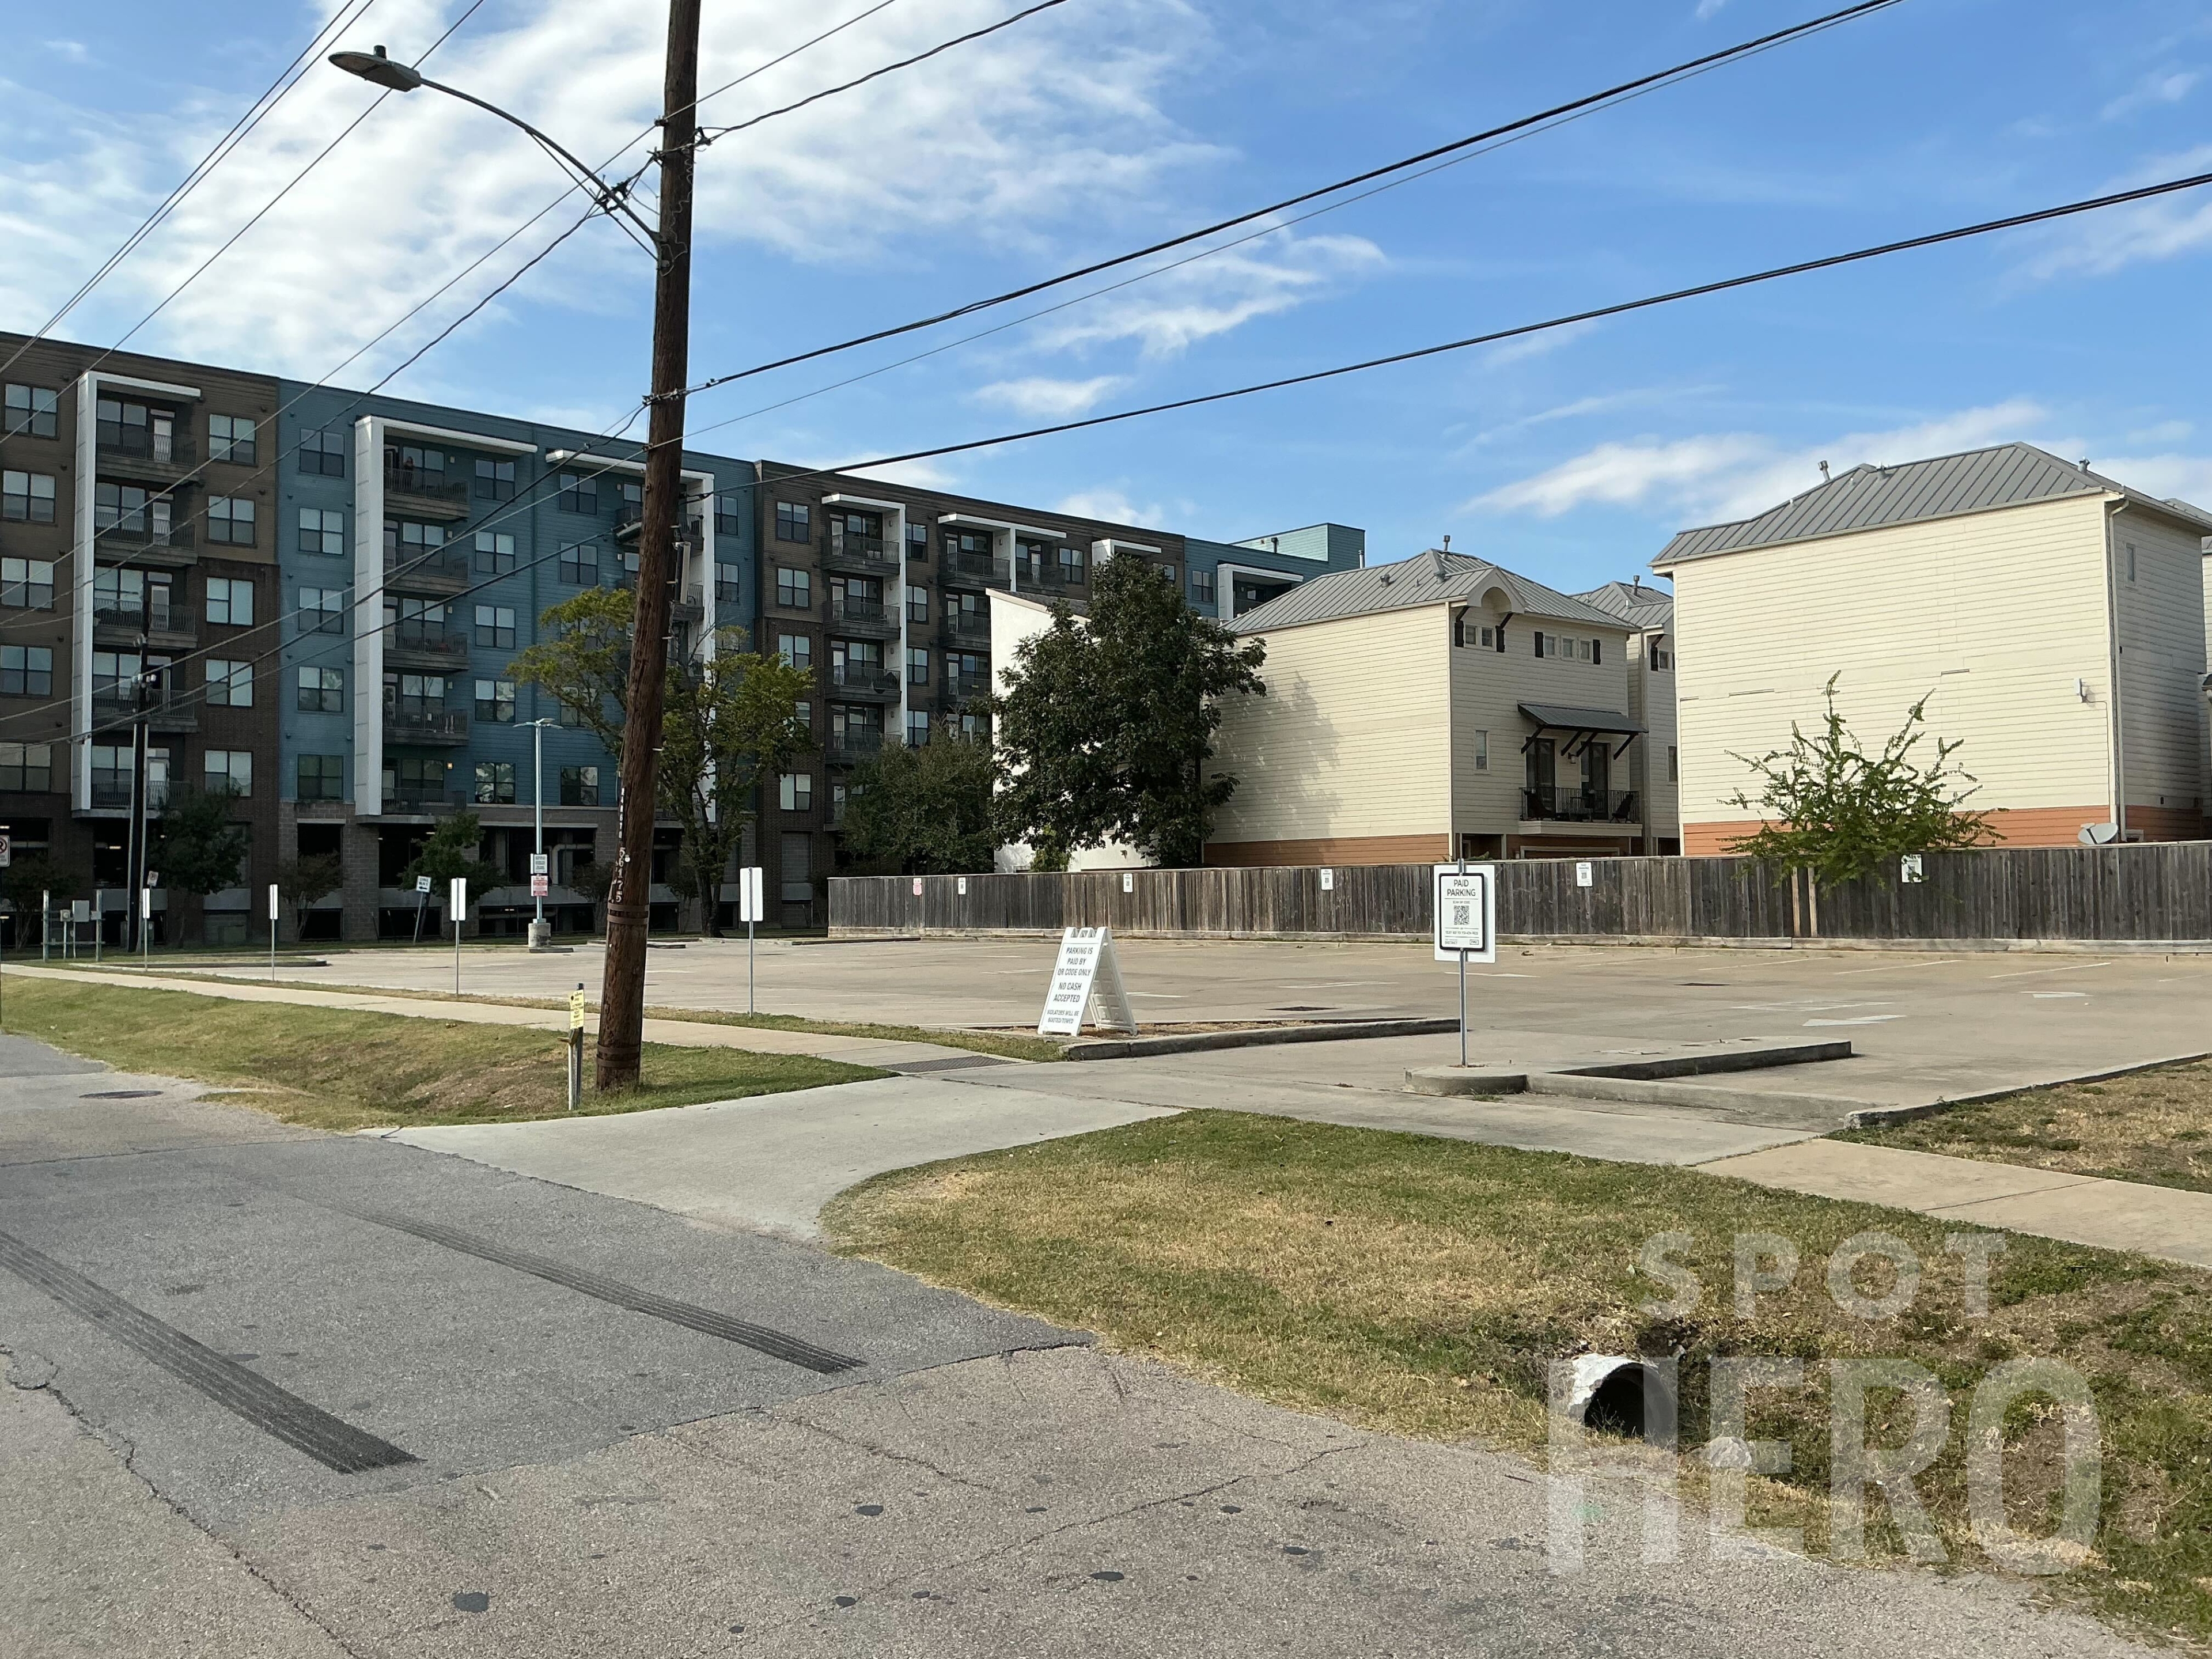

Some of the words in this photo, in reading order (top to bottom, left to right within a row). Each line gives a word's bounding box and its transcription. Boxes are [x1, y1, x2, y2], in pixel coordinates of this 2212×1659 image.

[616, 847, 626, 903] 56175
[1067, 982, 1082, 990] CASH
[1054, 994, 1080, 1002] ACCEPTED
